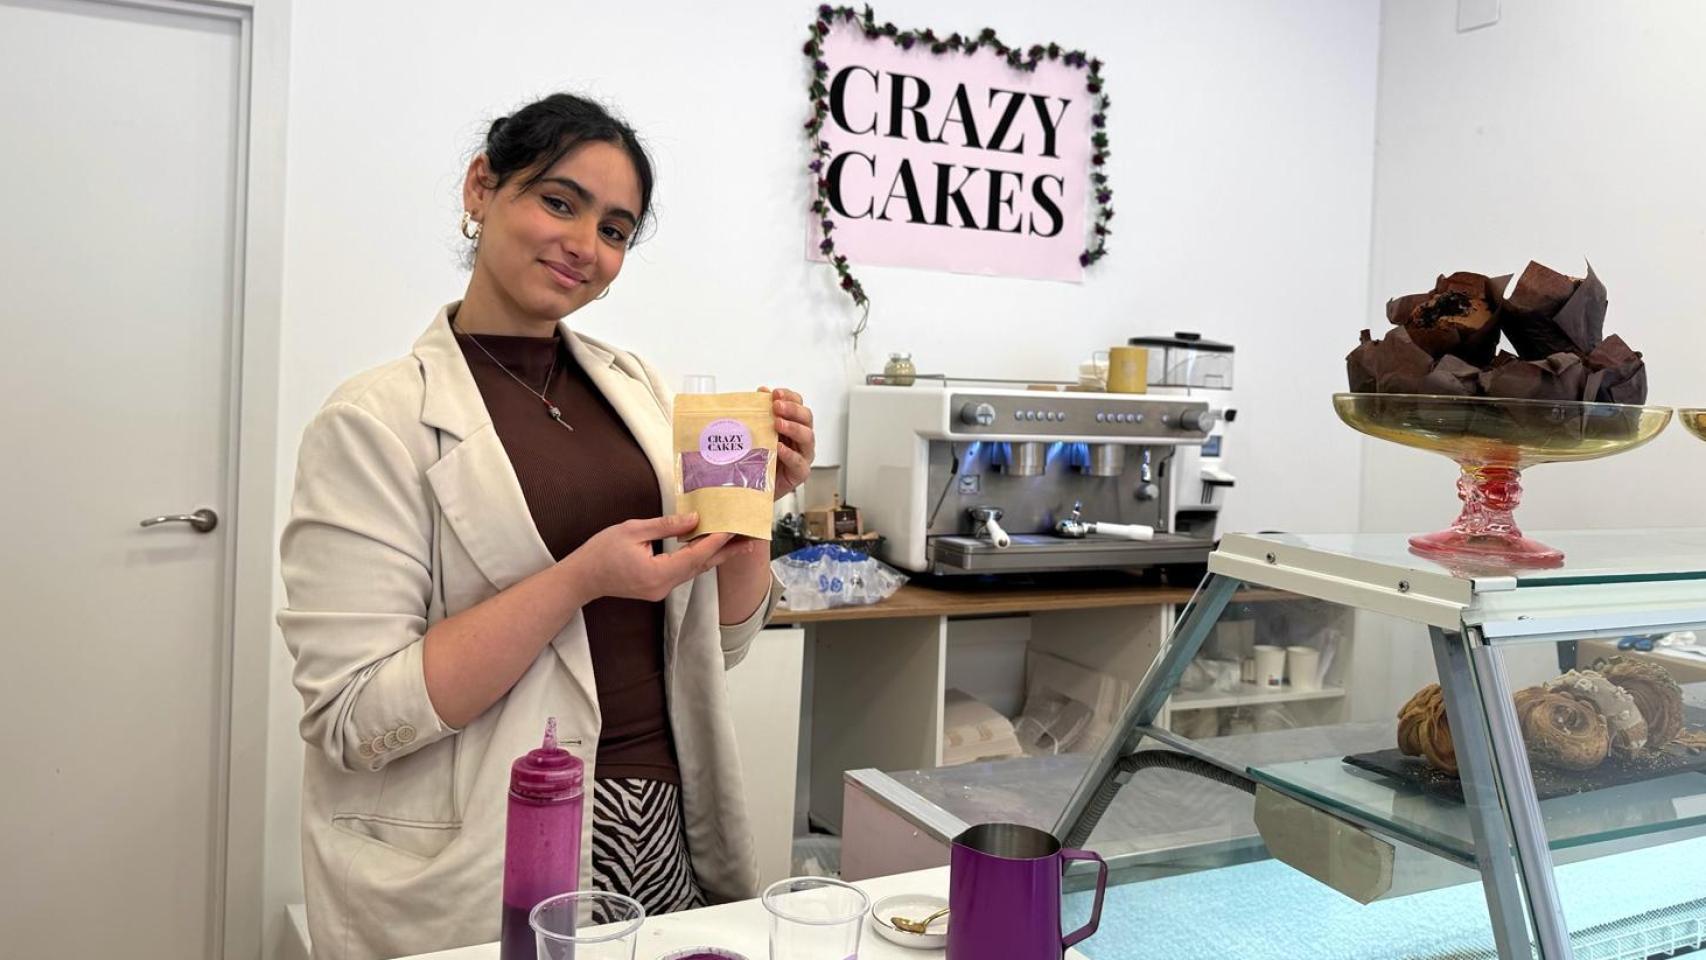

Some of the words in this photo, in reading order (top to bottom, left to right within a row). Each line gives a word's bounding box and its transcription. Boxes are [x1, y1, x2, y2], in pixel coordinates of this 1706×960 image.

[829, 65, 1072, 159] CRAZY
[825, 151, 1065, 238] CAKES
[707, 434, 744, 443] CRAZY
[707, 442, 744, 452] CAKES
